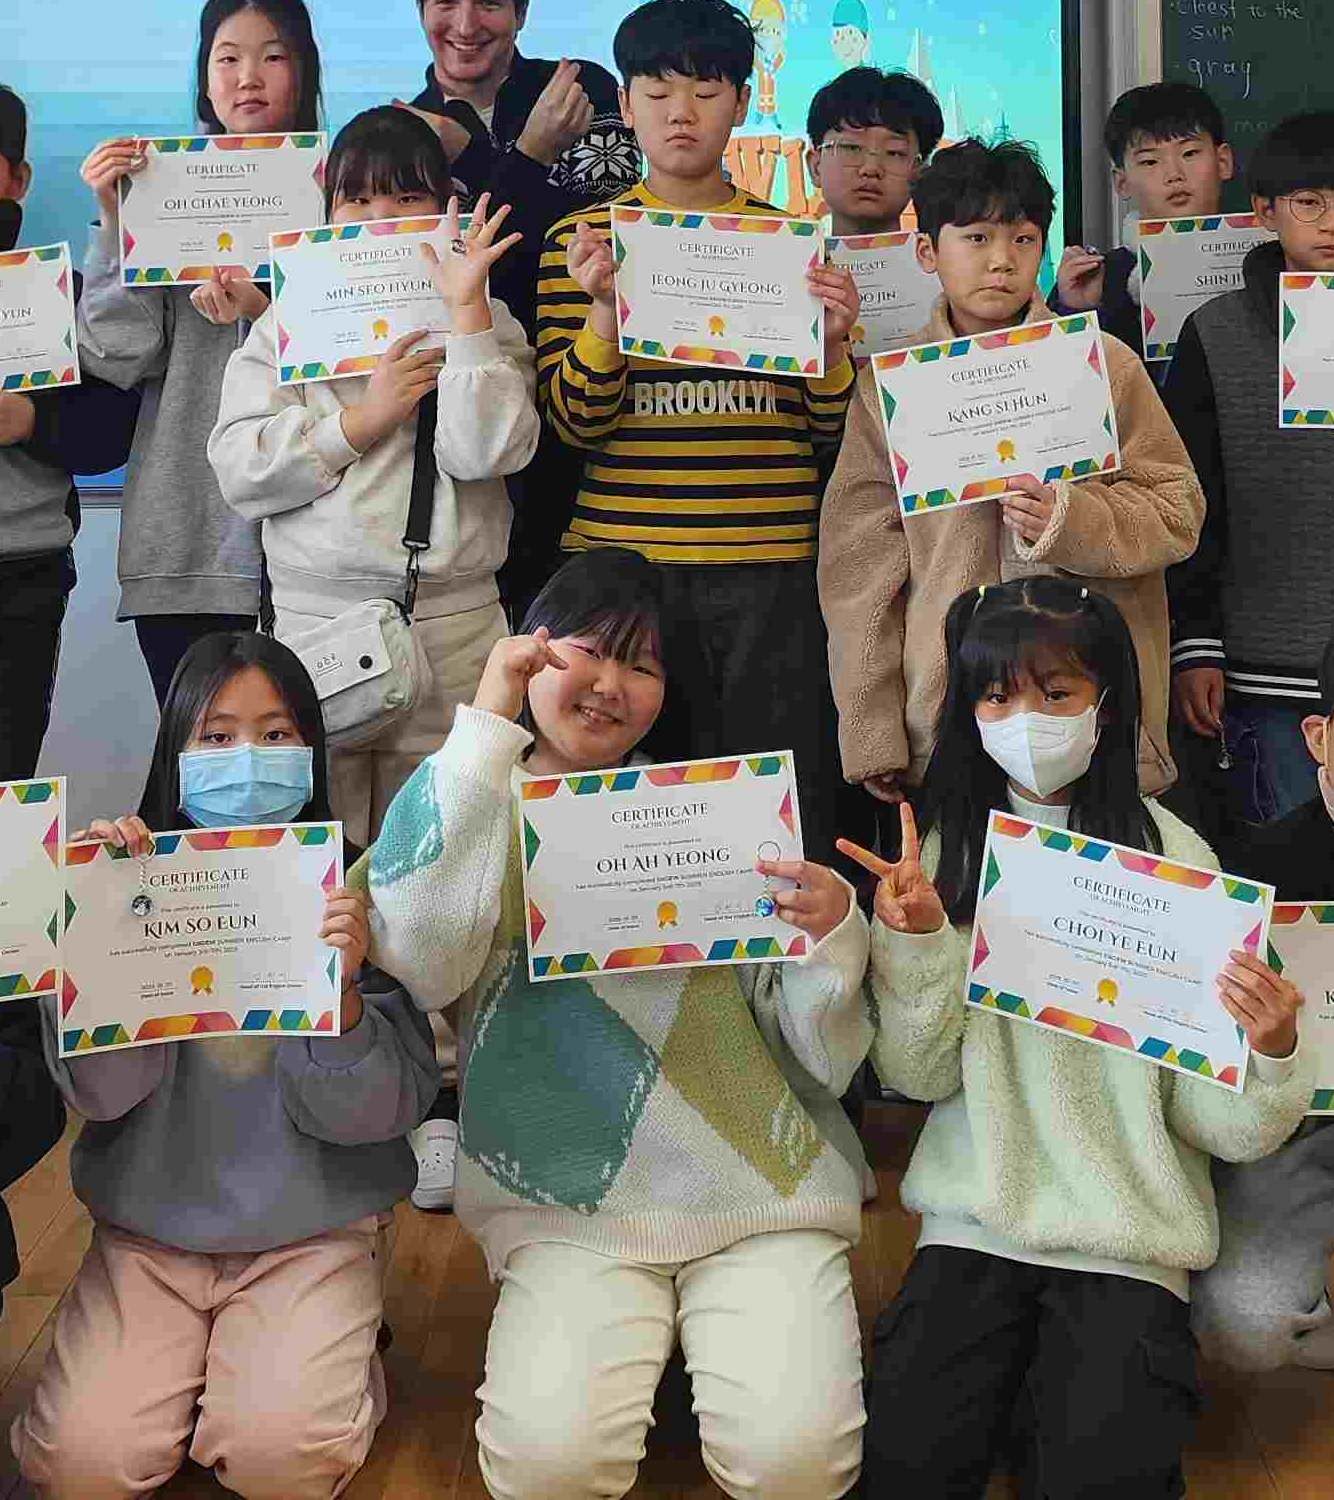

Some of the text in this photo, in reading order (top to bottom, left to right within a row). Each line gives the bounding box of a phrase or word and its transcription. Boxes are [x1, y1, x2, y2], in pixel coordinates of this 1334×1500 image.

[186, 163, 259, 175] CERTIFICATE
[164, 194, 283, 210] OH CHAE YEONG
[678, 242, 756, 258] CERTIFICATE
[324, 278, 433, 301] MIN SEO HYUN
[651, 273, 782, 296] JEONG JU GYEONG
[1194, 274, 1228, 288] SHIN
[950, 357, 1031, 383] CERTIFICATE
[633, 379, 780, 417] BROOKLYN
[947, 402, 992, 424] KANG
[1011, 391, 1048, 413] HUN
[610, 802, 708, 825] CERTIFICATE
[595, 847, 731, 875] OH AH YEONG
[148, 867, 250, 888] CERTIFICATE
[1072, 875, 1172, 915] CERTIFICATE
[143, 913, 259, 940] KIM SO EUN
[1052, 915, 1179, 963] CHOI YE EUN
